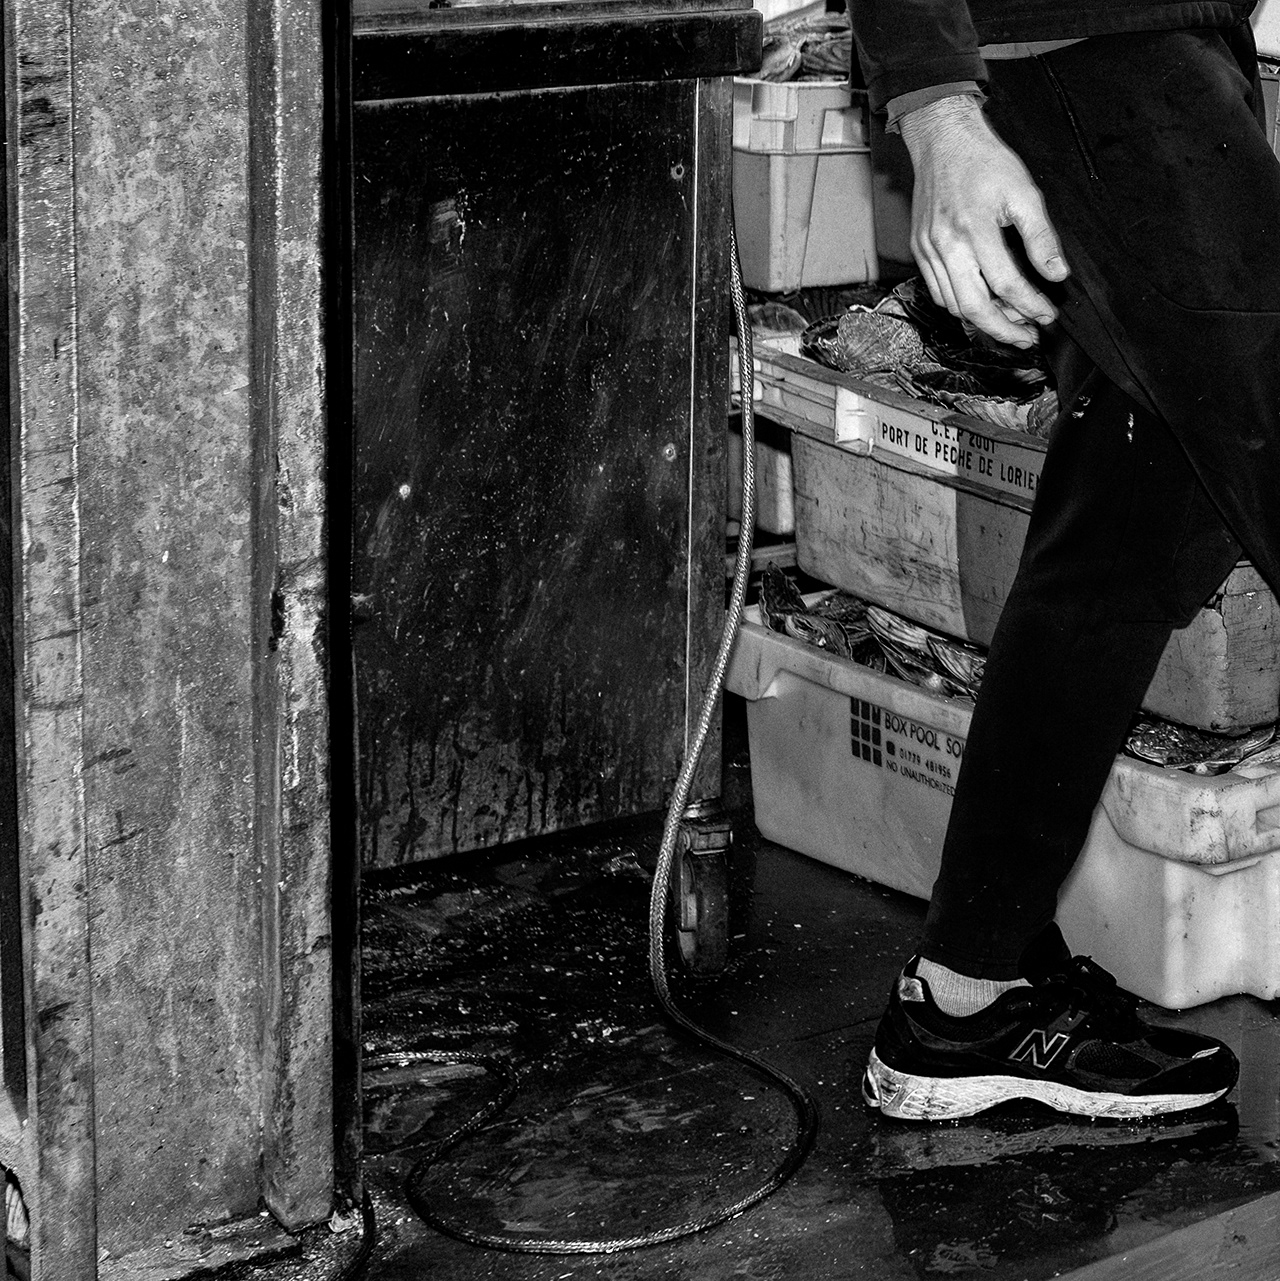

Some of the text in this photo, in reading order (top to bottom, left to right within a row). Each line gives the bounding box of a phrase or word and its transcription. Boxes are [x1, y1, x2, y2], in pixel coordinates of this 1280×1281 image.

[882, 422, 910, 448] PORT
[915, 434, 929, 455] DE
[935, 441, 973, 470] PECHE
[979, 456, 994, 477] DE
[885, 712, 908, 737] BOX
[910, 723, 941, 751] POOL
[886, 760, 898, 773] NO
[1008, 1028, 1071, 1069] N
